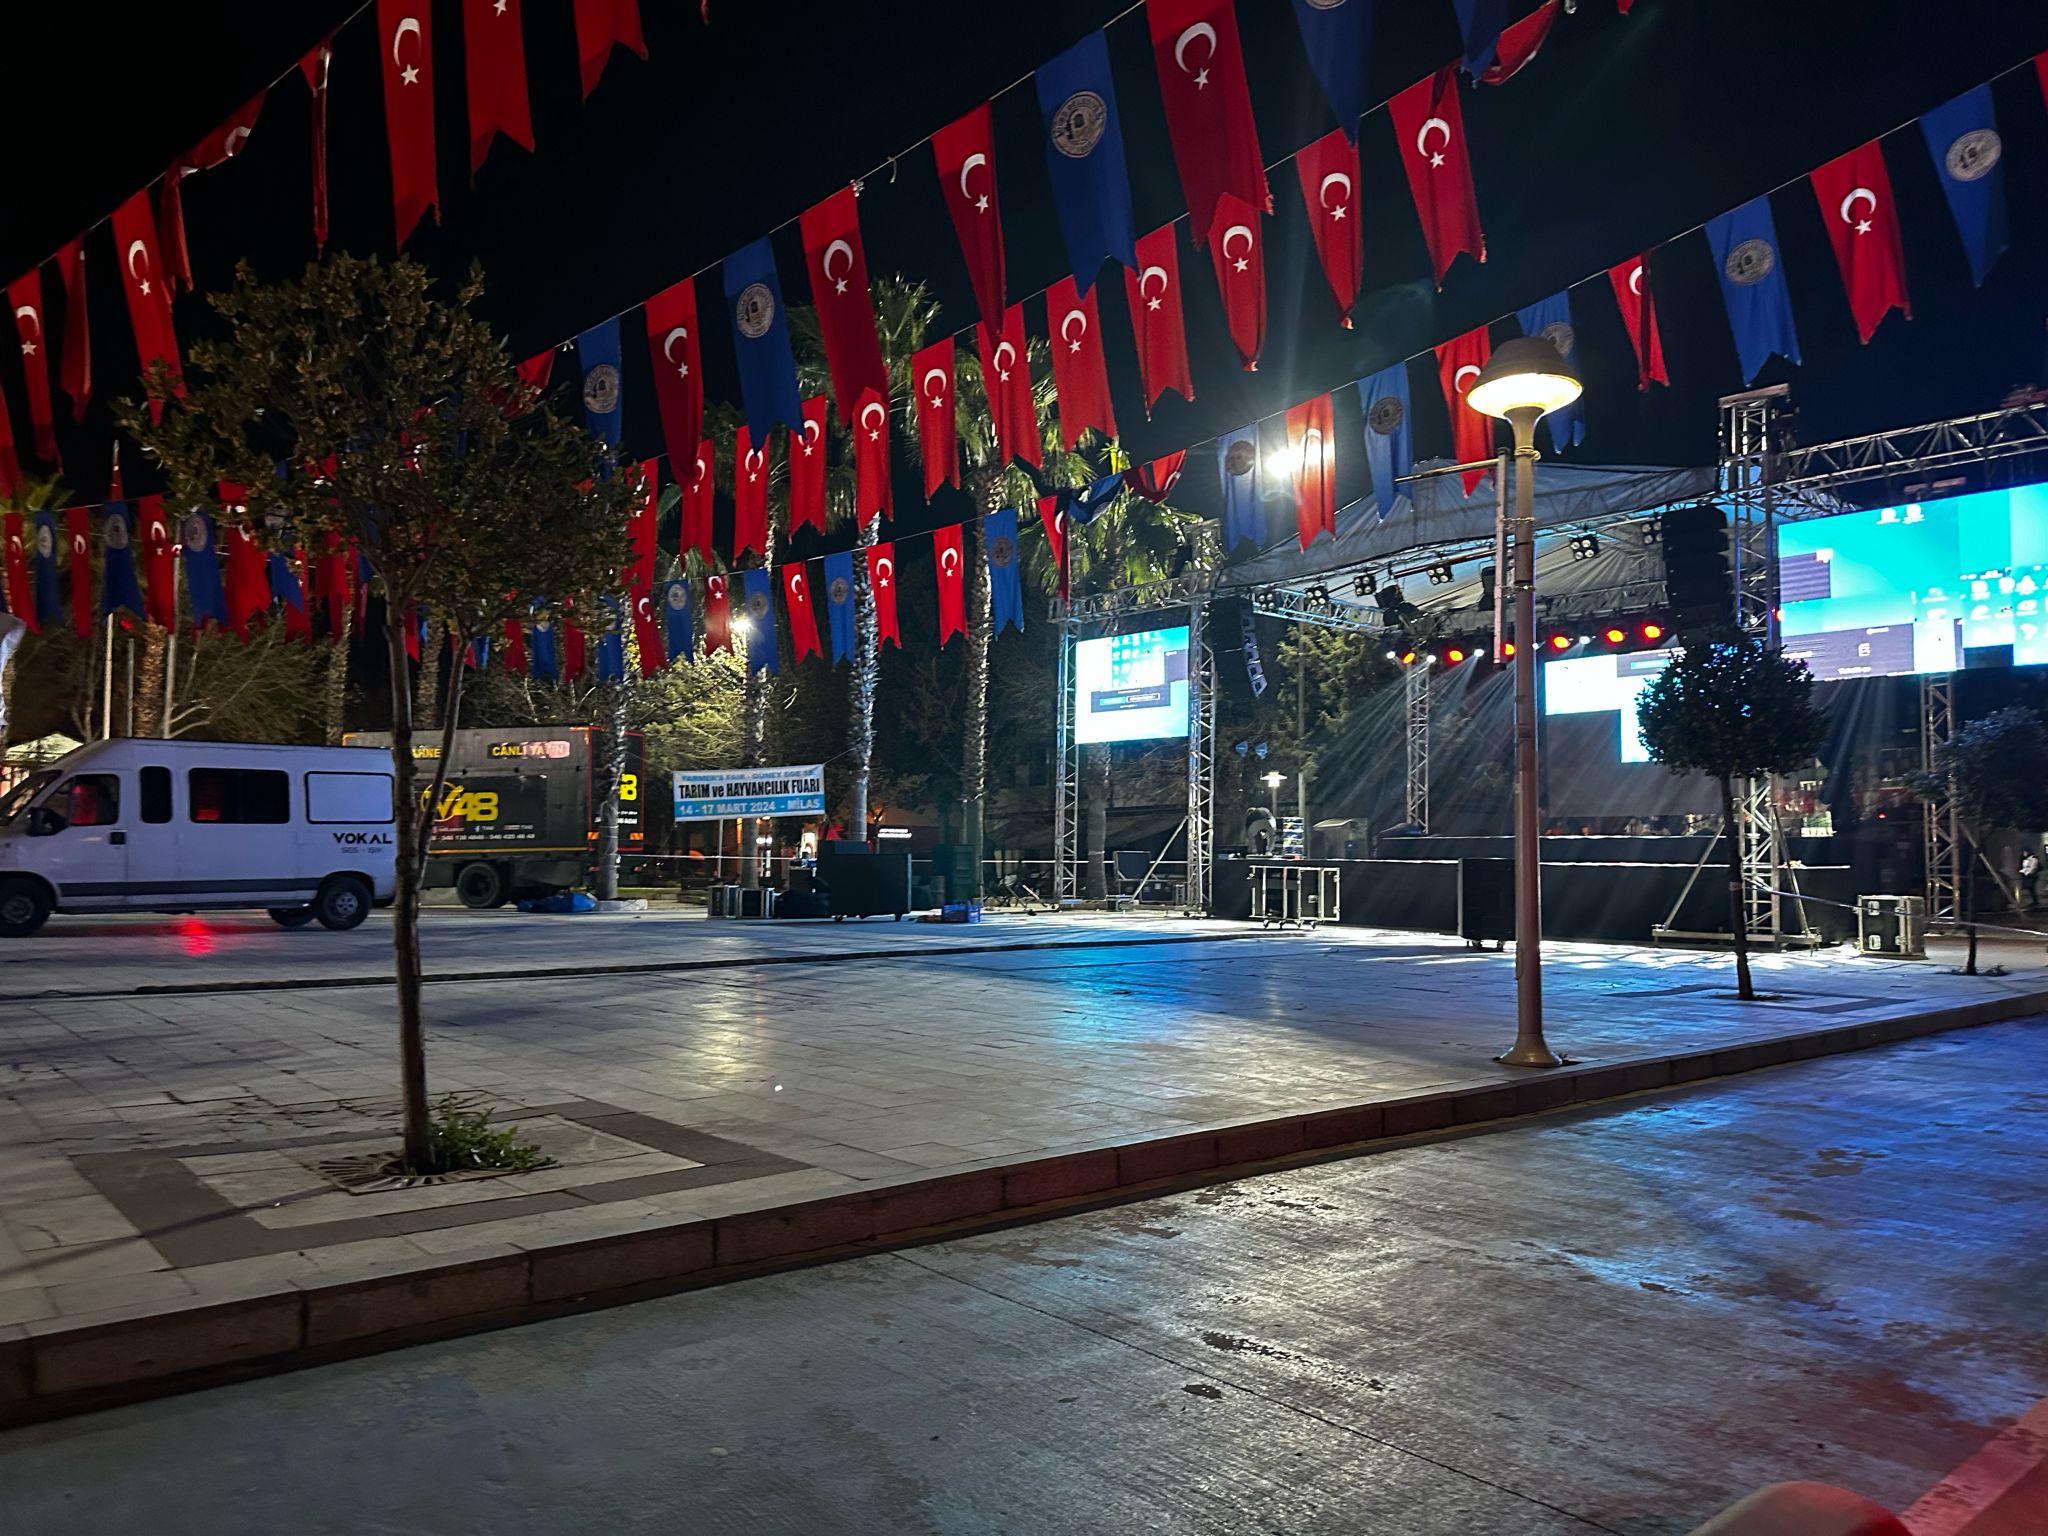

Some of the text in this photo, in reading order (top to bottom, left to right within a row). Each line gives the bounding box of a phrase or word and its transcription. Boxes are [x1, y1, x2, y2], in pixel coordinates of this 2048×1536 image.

[678, 778, 820, 799] TARIM ve HAYVANCILIK FUARI
[679, 805, 694, 815] 14
[701, 804, 714, 814] 17
[716, 803, 748, 814] MART
[750, 801, 776, 811] 2024
[787, 797, 821, 810] MİLAS
[332, 832, 393, 845] VOKAL
